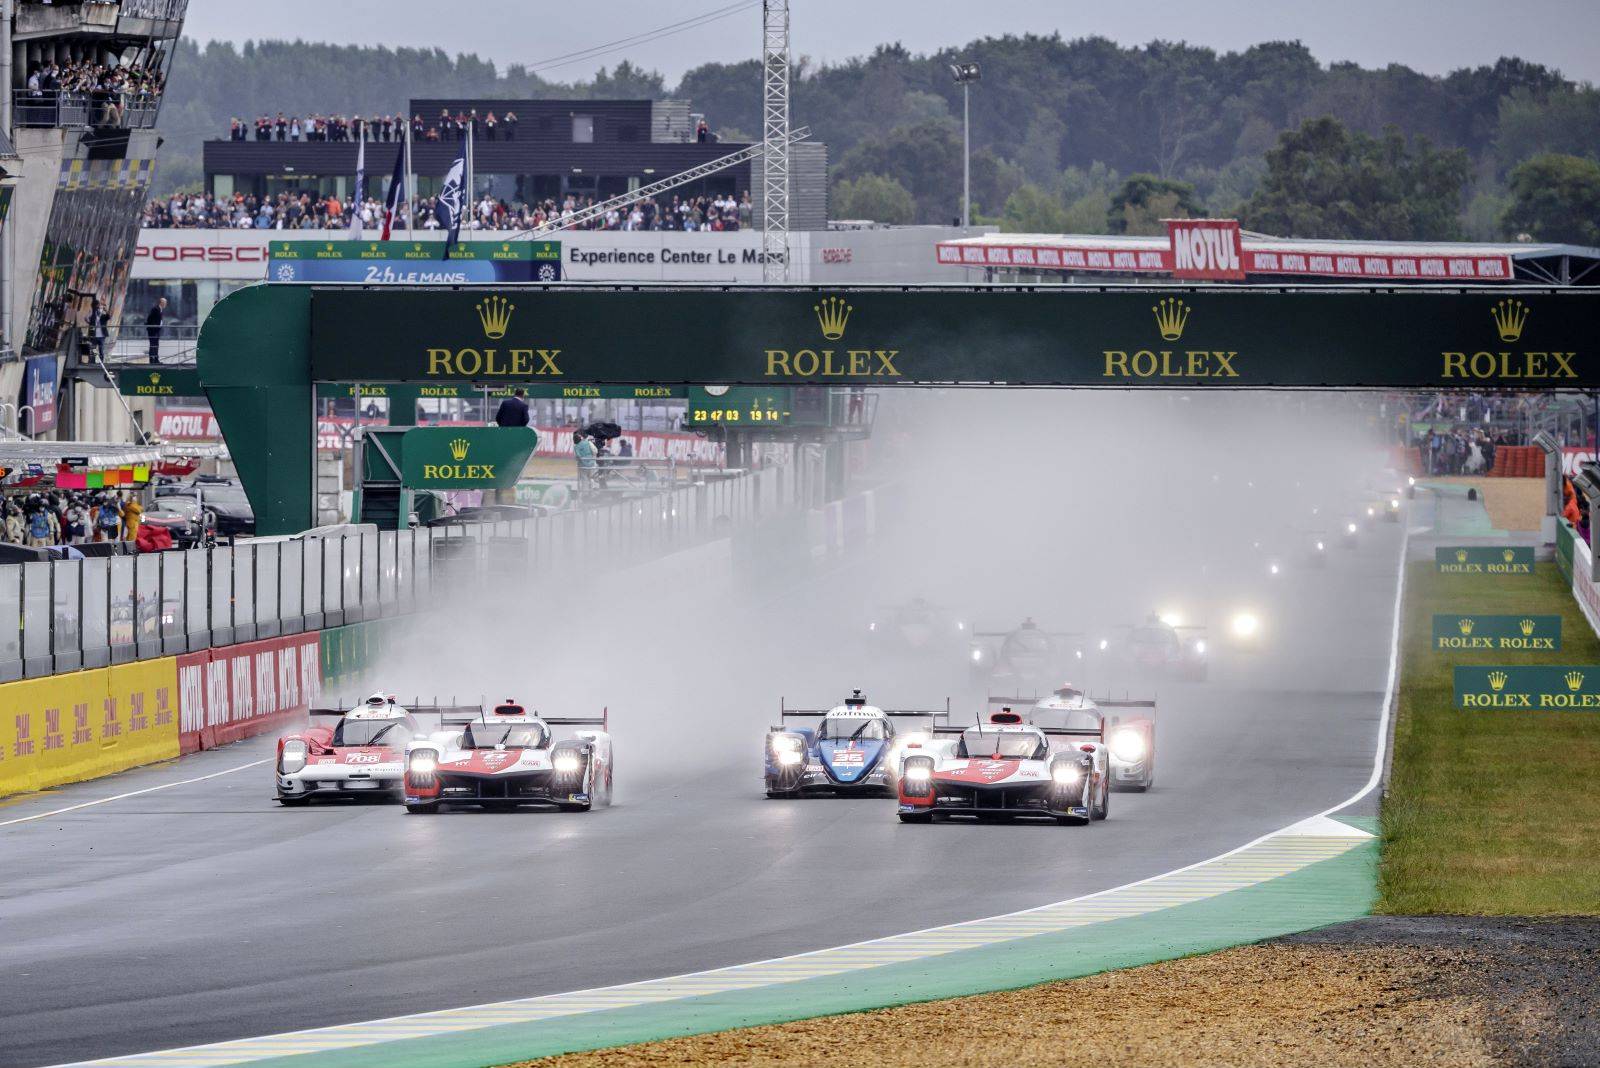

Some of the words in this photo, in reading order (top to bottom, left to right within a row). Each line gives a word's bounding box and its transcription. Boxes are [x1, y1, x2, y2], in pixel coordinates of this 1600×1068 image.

[274, 250, 298, 258] ROLEX
[317, 250, 343, 258] ROLEX
[361, 250, 386, 258] ROLEX
[405, 250, 431, 258] ROLEX
[449, 250, 475, 258] ROLEX
[493, 250, 519, 258] ROLEX
[536, 250, 559, 258] ROLEX
[1174, 228, 1240, 271] MOTUL
[570, 248, 655, 266] Experience
[661, 249, 711, 264] Center
[718, 249, 736, 264] Le
[420, 272, 466, 282] MANS
[426, 348, 563, 375] ROLEX
[764, 350, 901, 376] ROLEX
[1102, 350, 1239, 377] ROLEX
[1441, 352, 1578, 378] ROLEX
[136, 385, 174, 394] ROLEX
[420, 387, 458, 396] ROLEX
[563, 388, 600, 396] ROLEX
[634, 388, 672, 396] ROLEX
[694, 410, 707, 421] 23
[711, 410, 723, 421] 47
[726, 410, 739, 421] 03
[750, 410, 762, 421] 19
[766, 410, 778, 421] 14
[160, 415, 203, 436] MOTUL
[423, 465, 496, 479] ROLEX
[1440, 564, 1482, 573] ROLEX
[1487, 564, 1530, 573] ROLEX
[1438, 637, 1494, 648] ROLEX
[1500, 638, 1554, 649] ROLEX
[1462, 693, 1532, 707] ROLEX
[350, 754, 379, 763] 708
